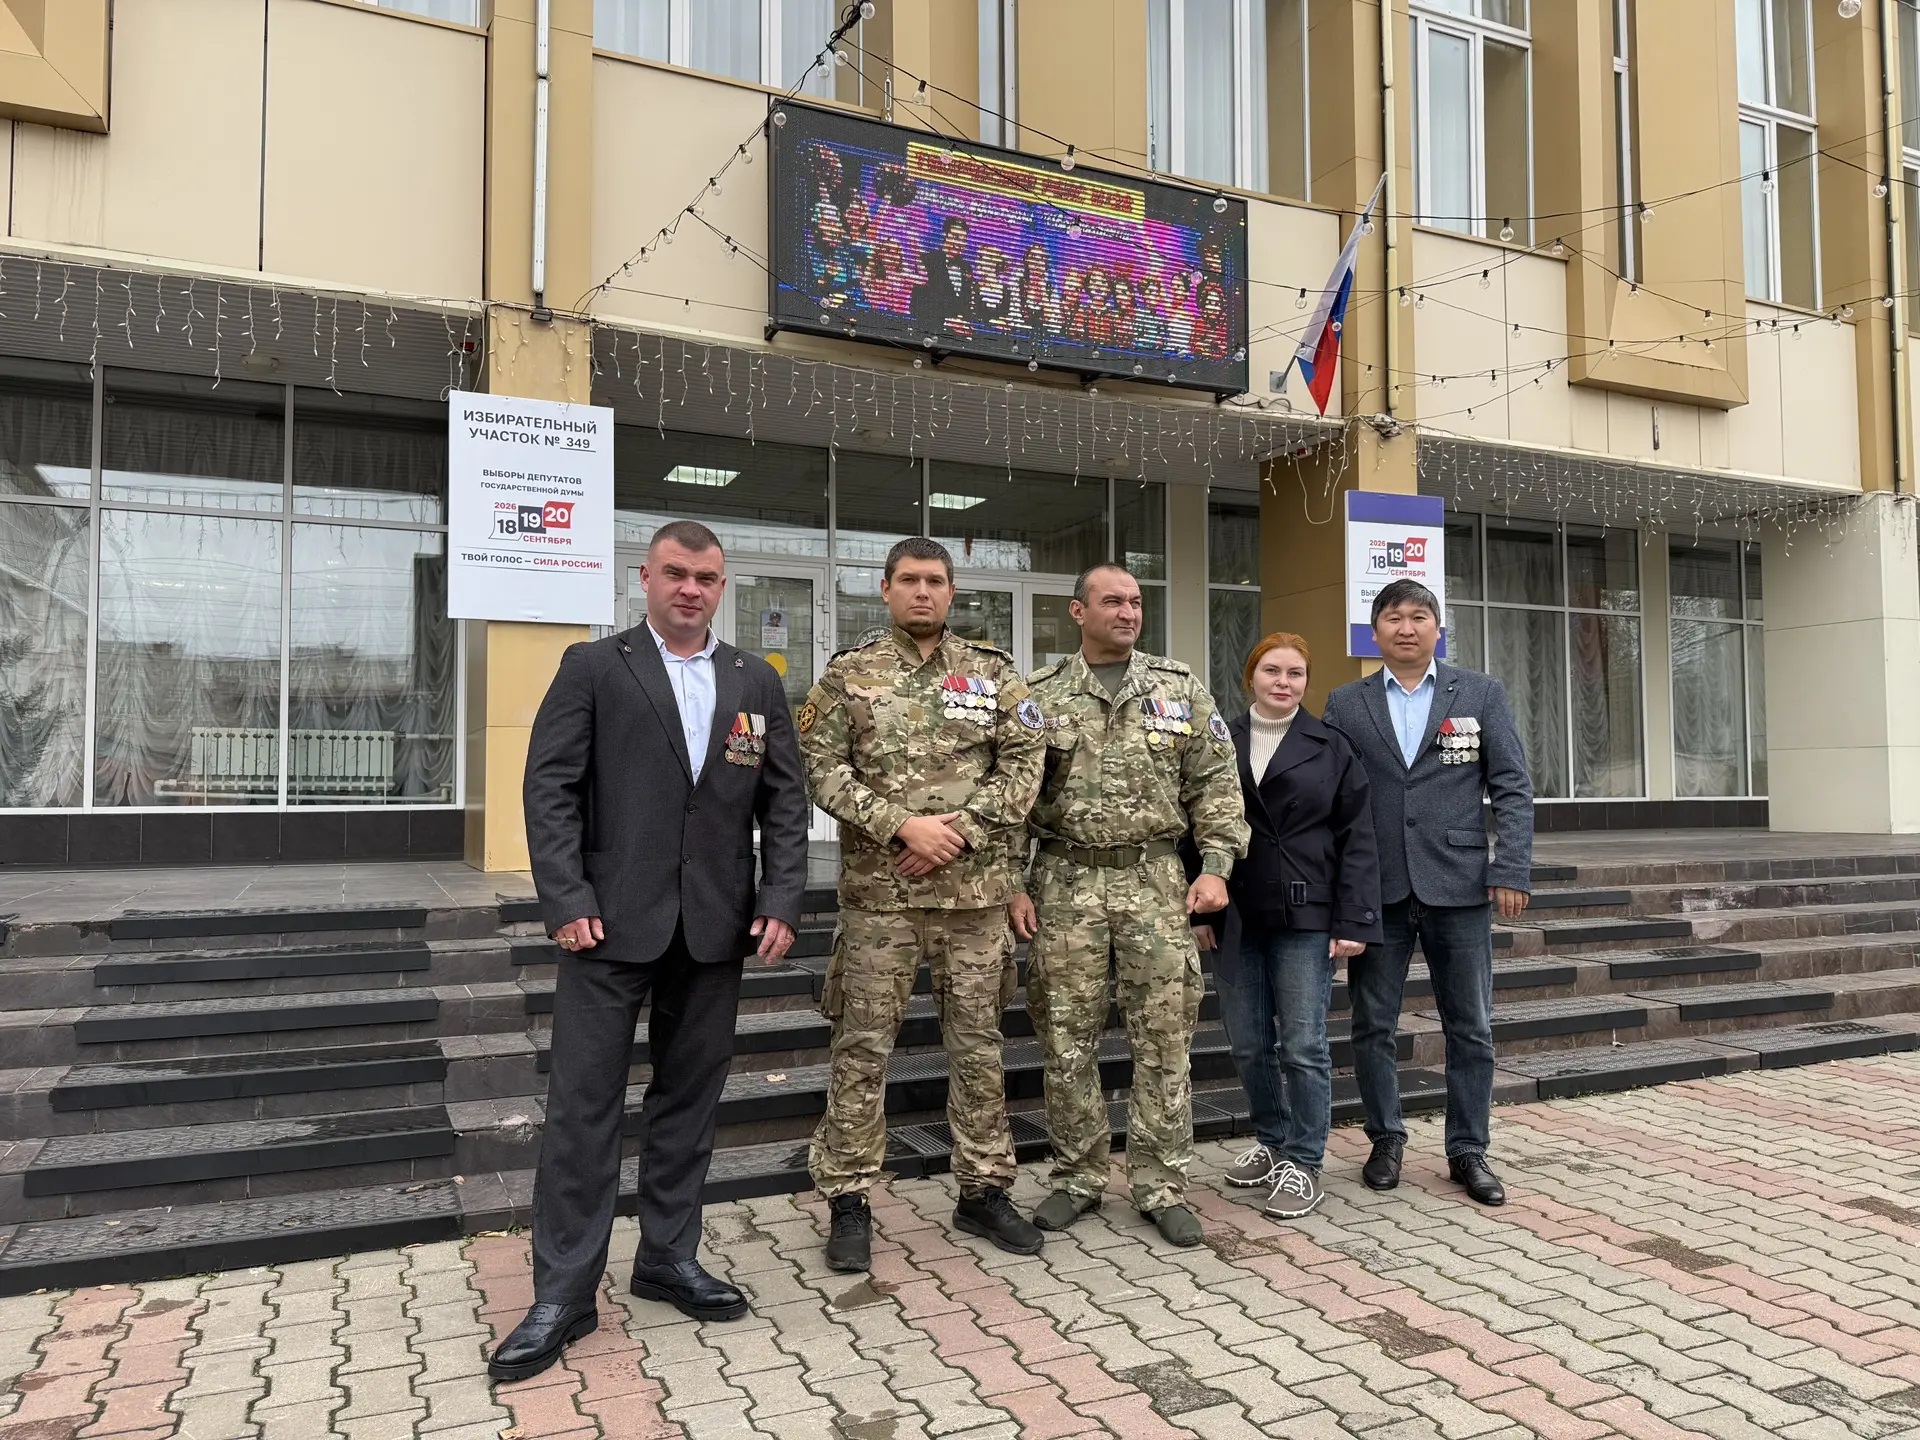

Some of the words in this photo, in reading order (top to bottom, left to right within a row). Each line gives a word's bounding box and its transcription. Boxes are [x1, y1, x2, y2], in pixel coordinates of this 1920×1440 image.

[463, 410, 597, 434] ИЗБИРАТЕЛЬНЫЙ
[469, 427, 540, 445] УЧАСТОК
[545, 435, 560, 447] №
[566, 437, 590, 449] 349
[483, 469, 525, 480] ВЫБОРЫ
[527, 472, 582, 485] ДЕПУТАТОВ
[480, 482, 559, 495] ГОСУДАРСТВЕННОЙ
[494, 502, 517, 510] 2026
[497, 519, 517, 534] 18
[520, 512, 541, 528] 19
[544, 507, 569, 523] 20
[523, 535, 572, 545] СЕНТЯБРЯ
[461, 553, 488, 562] ТВОЙ
[490, 554, 522, 564] ГОЛОС
[533, 558, 559, 566] СИЛА
[562, 560, 602, 569] РОССИИ!
[1372, 555, 1386, 569] 18
[1389, 548, 1403, 562] 19
[1406, 543, 1423, 557] 20
[1390, 569, 1426, 577] СЕНТЯБРЯ
